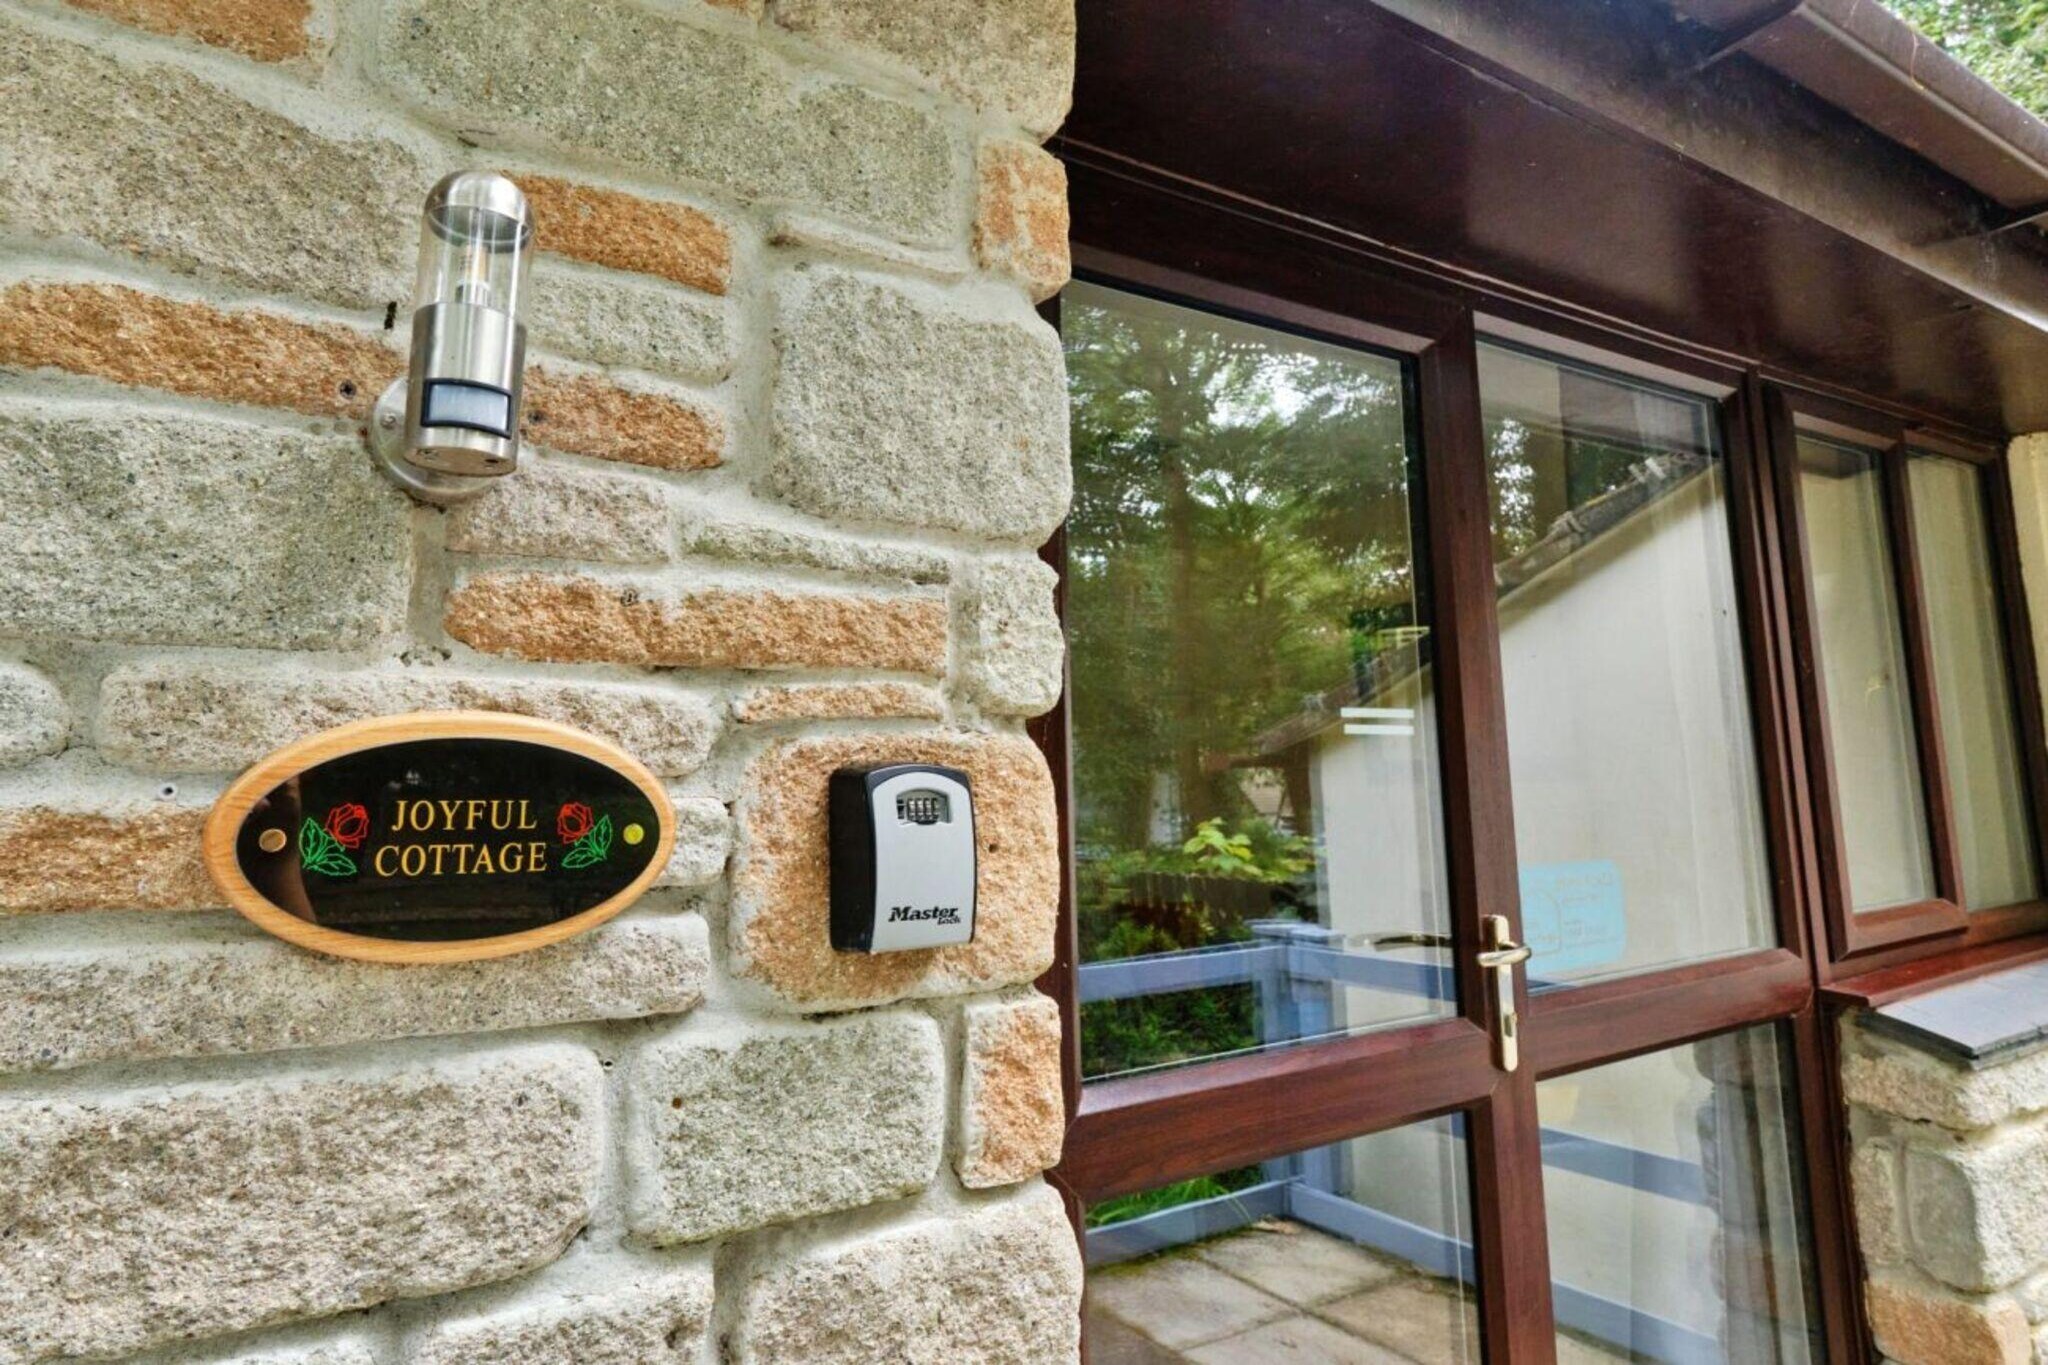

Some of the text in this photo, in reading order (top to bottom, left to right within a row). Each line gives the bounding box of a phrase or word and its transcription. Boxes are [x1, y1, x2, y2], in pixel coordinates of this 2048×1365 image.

[391, 799, 538, 832] JOYFUL
[374, 842, 548, 877] COTTAGE
[888, 905, 959, 922] Master
